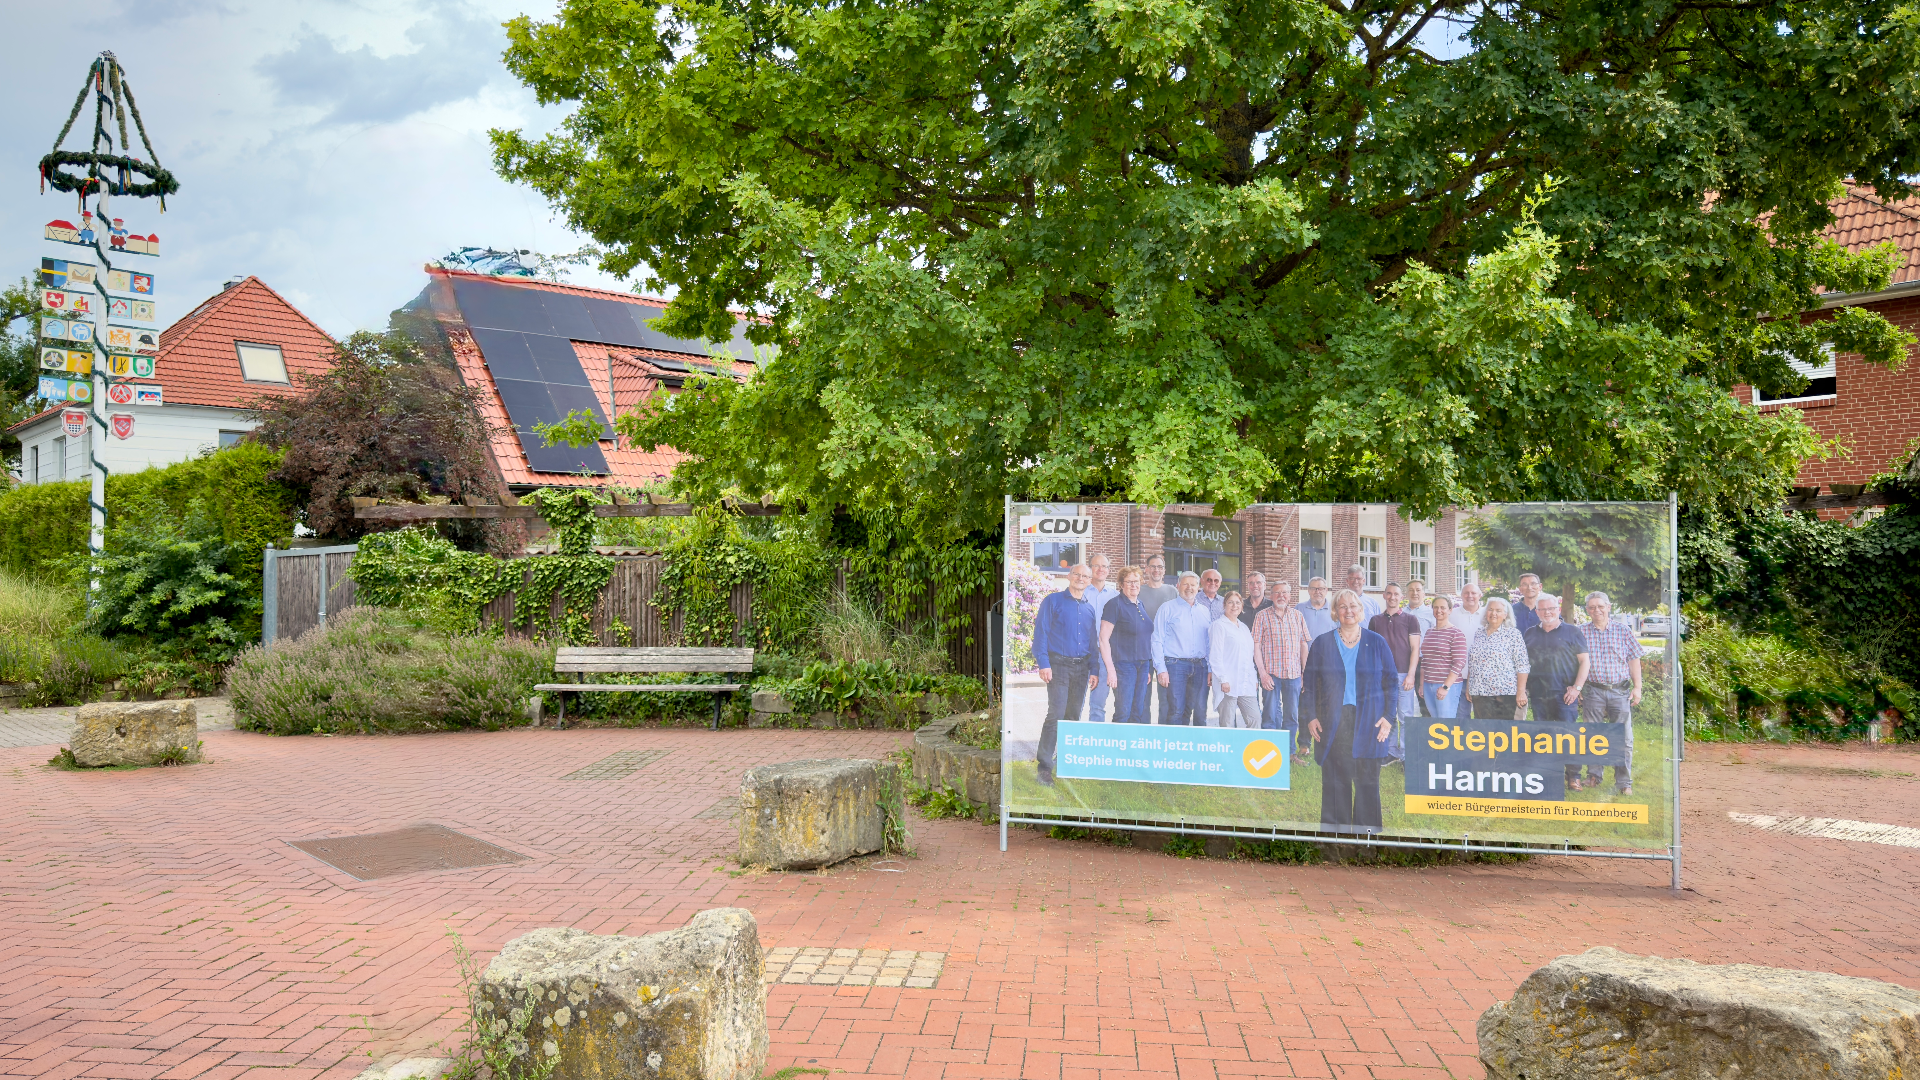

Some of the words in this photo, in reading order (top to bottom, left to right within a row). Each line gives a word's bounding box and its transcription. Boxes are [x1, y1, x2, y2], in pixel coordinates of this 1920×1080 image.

[1038, 518, 1089, 535] CDU
[1172, 526, 1227, 543] RATHAUS
[1064, 734, 1127, 751] Erfahrung
[1130, 737, 1161, 750] zählt
[1163, 738, 1194, 752] jetzt
[1197, 740, 1234, 753] mehr.
[1427, 722, 1610, 759] Stephanie
[1064, 753, 1113, 768] Stephie
[1115, 758, 1150, 769] muss
[1152, 758, 1197, 771] wieder
[1200, 760, 1225, 772] her.
[1428, 762, 1545, 795] Harms
[1427, 800, 1463, 811] wieder
[1465, 802, 1551, 816] Bürgermeisterin
[1553, 805, 1570, 816] für
[1571, 806, 1638, 821] Ronnenberg
